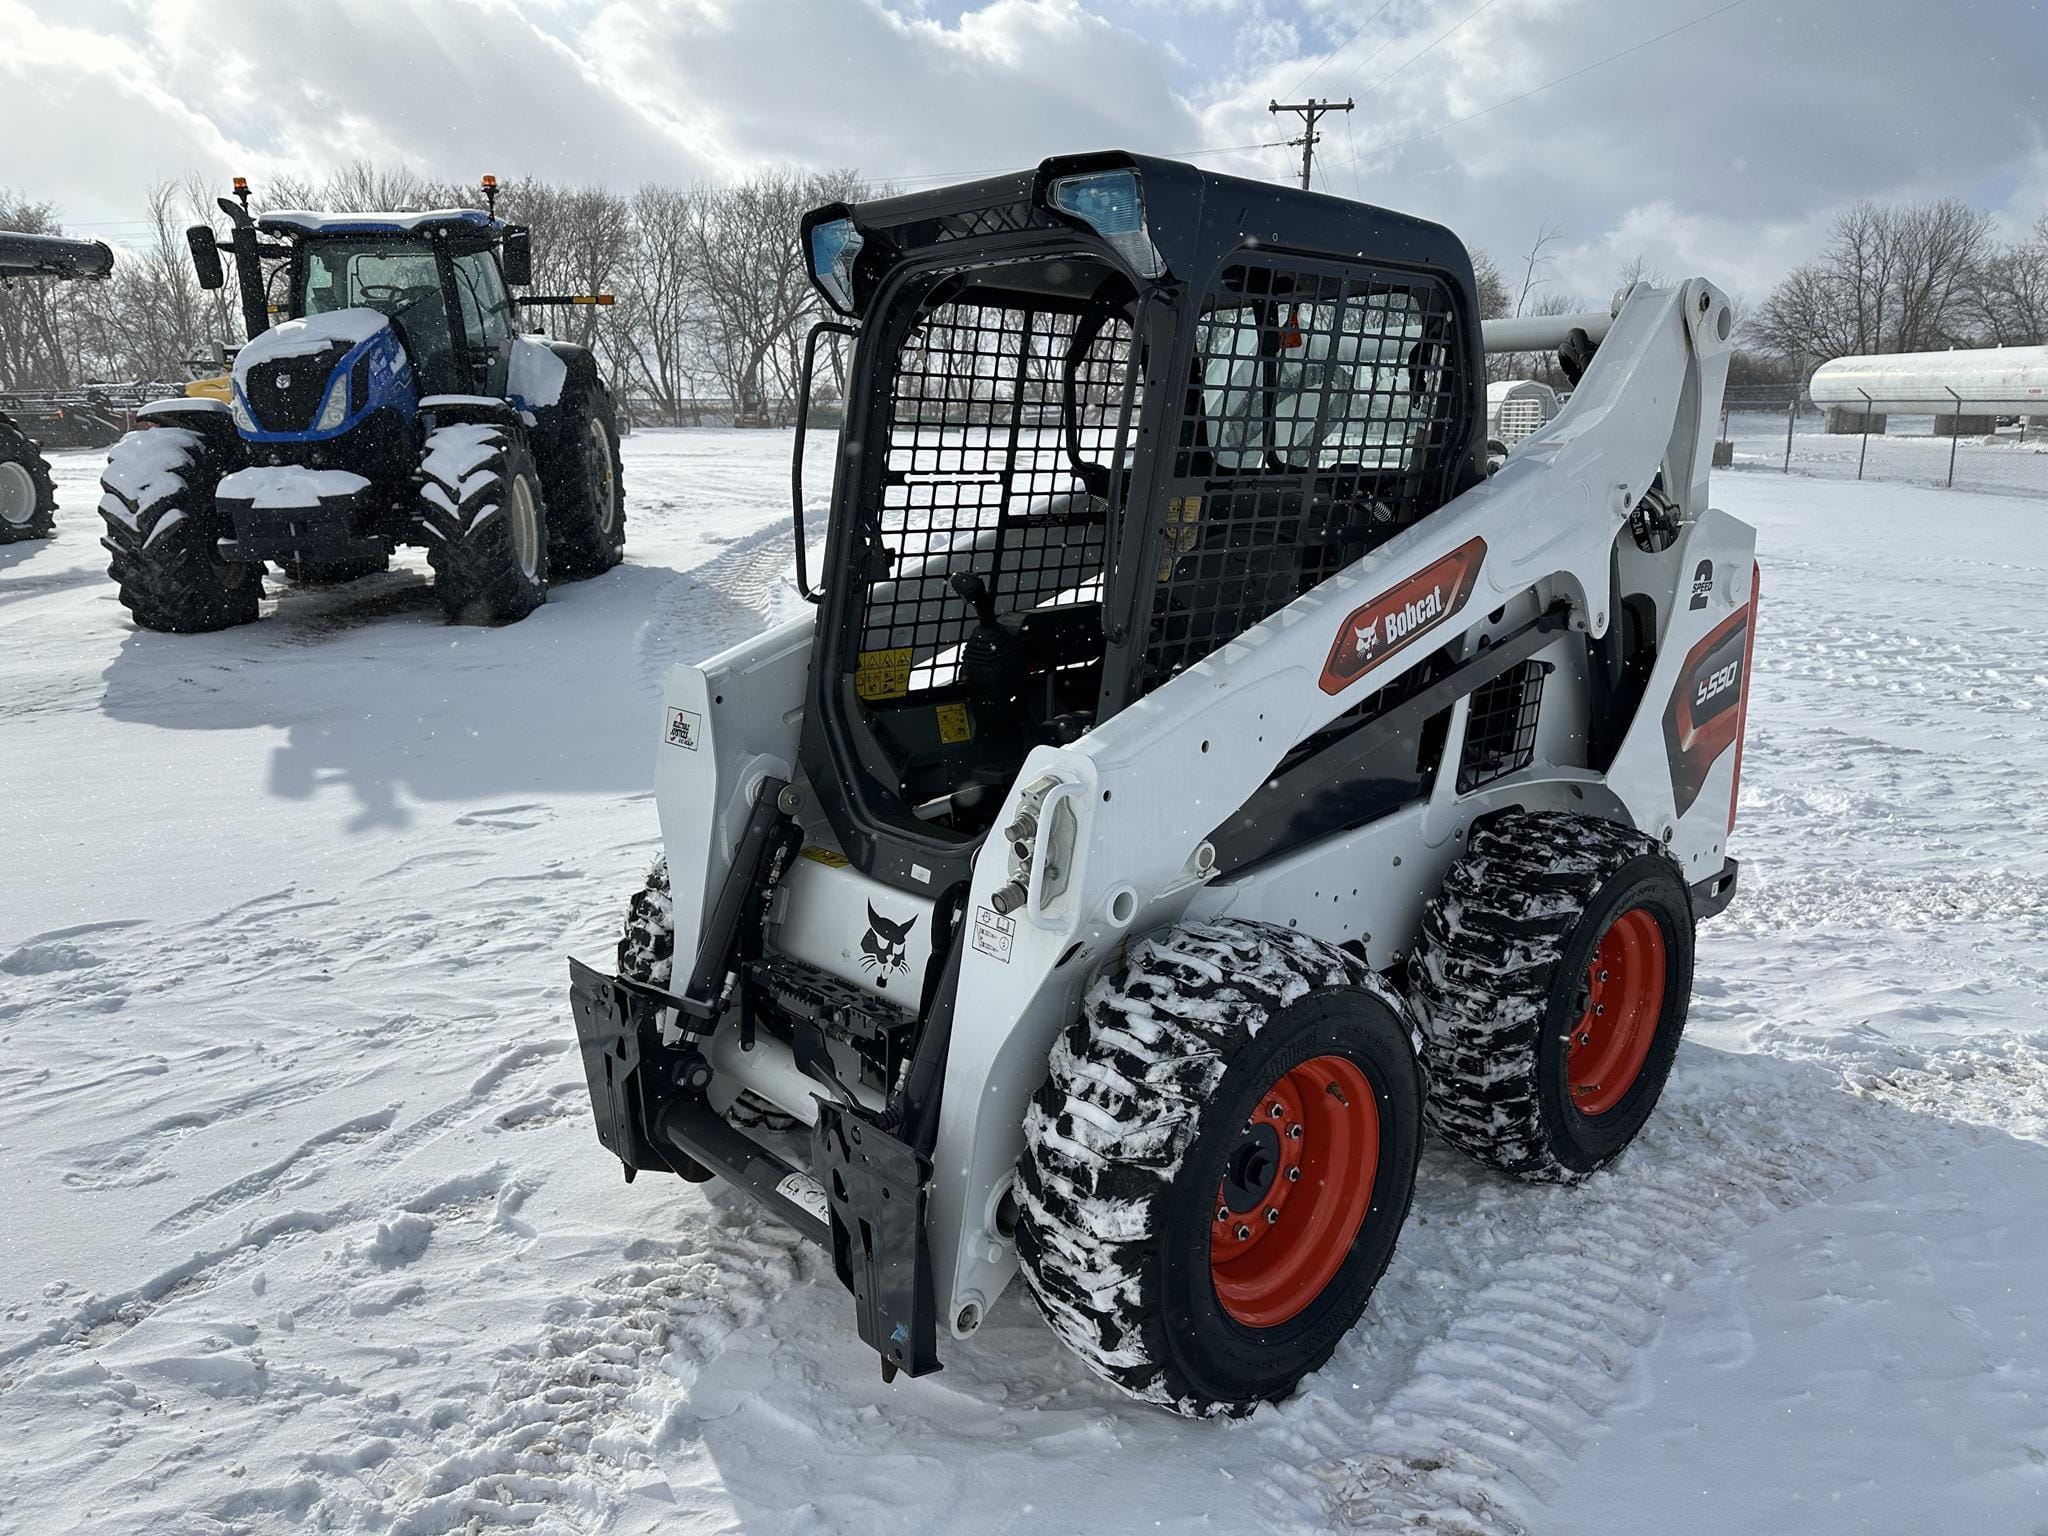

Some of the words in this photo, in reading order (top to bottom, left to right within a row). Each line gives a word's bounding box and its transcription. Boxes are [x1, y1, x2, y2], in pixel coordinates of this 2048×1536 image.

[1689, 559, 1713, 611] 2
[1691, 582, 1713, 593] SPEED
[1384, 584, 1442, 645] Bobcat
[1696, 660, 1738, 706] S590
